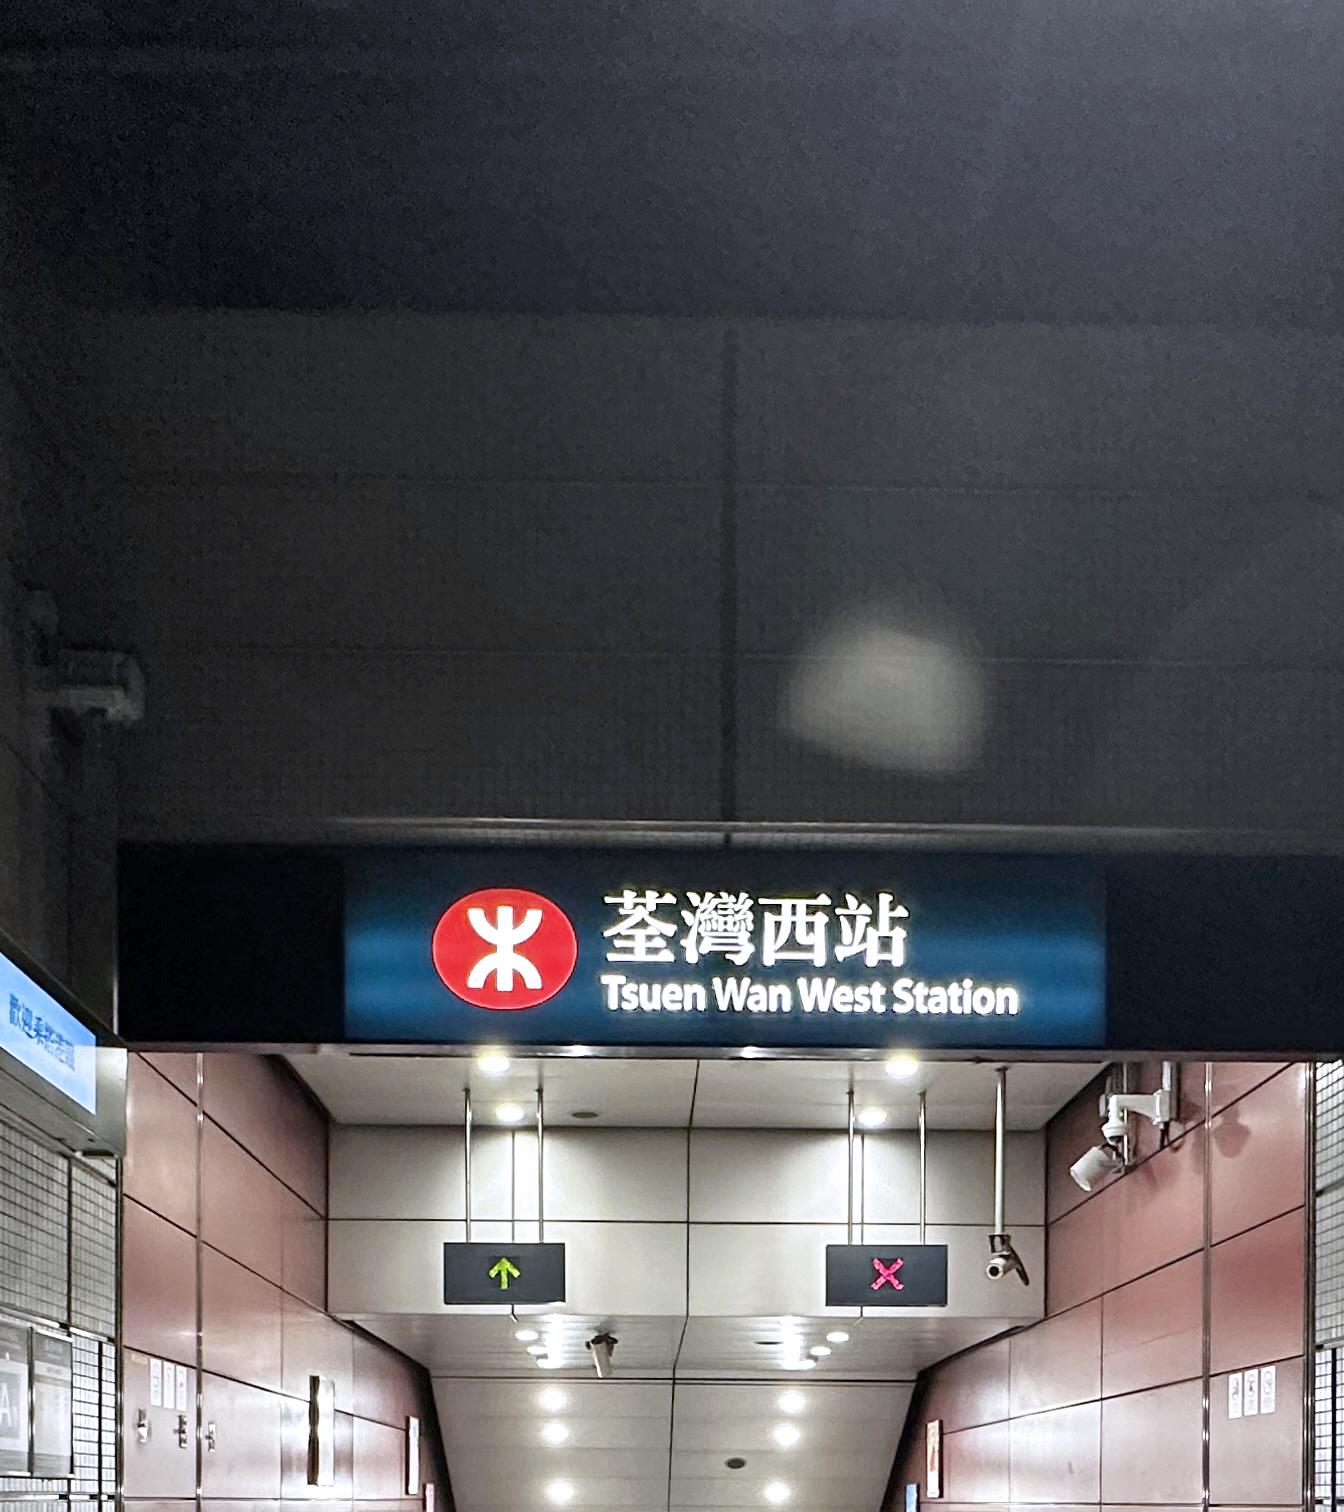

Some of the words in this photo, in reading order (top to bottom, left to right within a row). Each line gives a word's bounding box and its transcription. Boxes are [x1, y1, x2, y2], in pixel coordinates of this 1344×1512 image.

[603, 889, 910, 967] 荃灣西站
[600, 974, 707, 1011] Tsuen
[712, 976, 792, 1012] Wan
[797, 976, 887, 1013] West
[892, 977, 1019, 1015] Station
